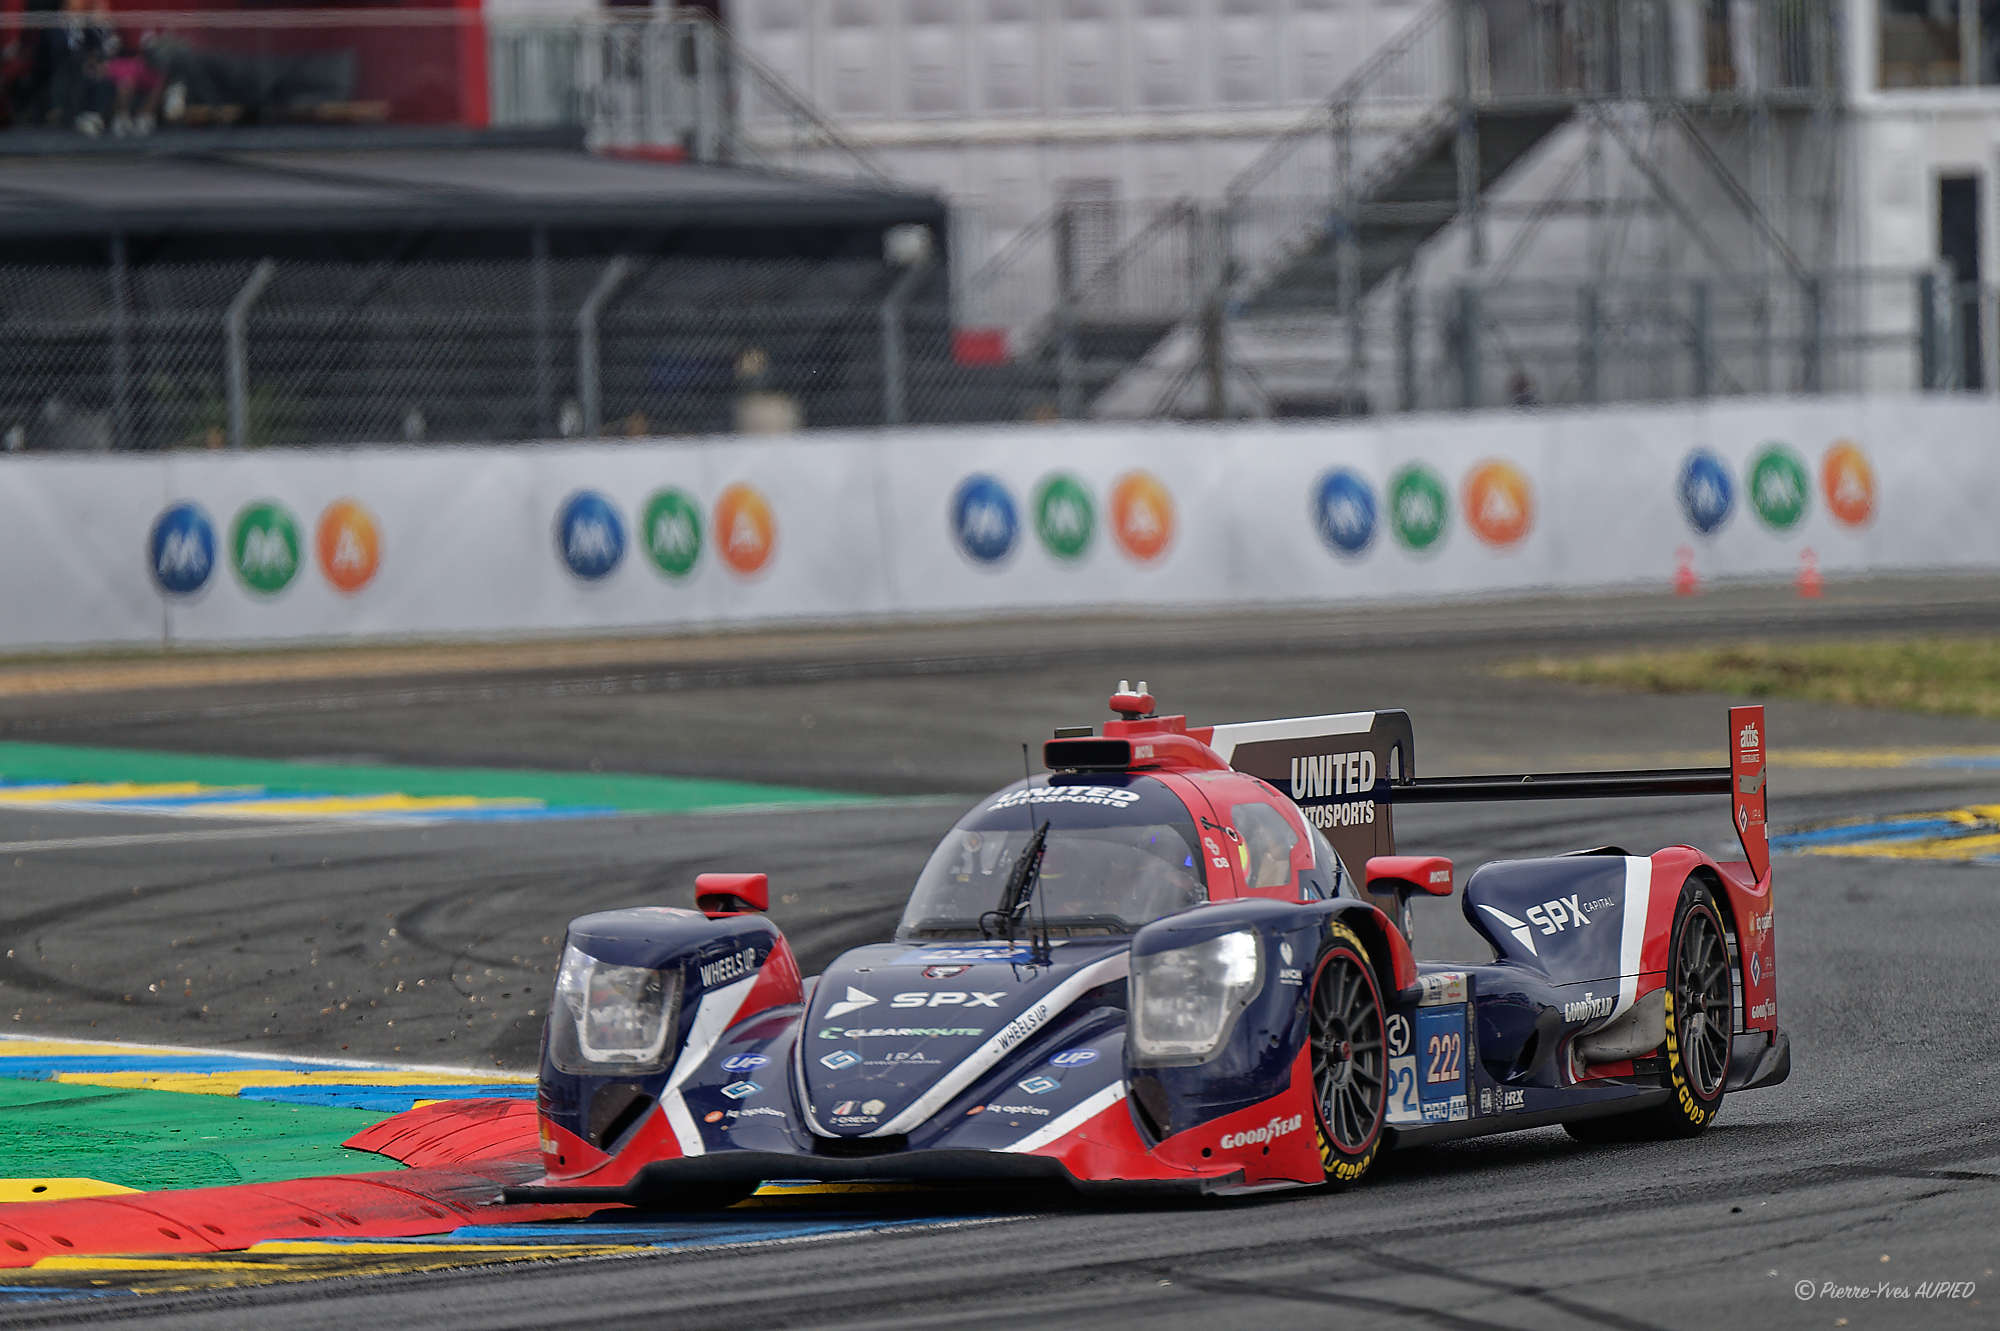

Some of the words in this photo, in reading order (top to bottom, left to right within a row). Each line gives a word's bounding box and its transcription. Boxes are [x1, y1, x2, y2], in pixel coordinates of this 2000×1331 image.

[1290, 750, 1376, 800] UNITED
[997, 785, 1141, 803] UNITED
[1526, 893, 1592, 935] SPX
[1583, 896, 1615, 912] CAPITAL
[700, 952, 745, 987] WHEELS
[742, 947, 757, 971] UP
[890, 991, 1009, 1008] SPX
[1564, 992, 1613, 1026] GOODYEAR
[998, 1012, 1036, 1050] WHEELS
[1033, 1004, 1048, 1022] UP
[1053, 1051, 1097, 1064] UP
[1426, 1031, 1462, 1085] 222
[1504, 1089, 1525, 1106] HRX
[1220, 1114, 1302, 1149] GOODYEAR
